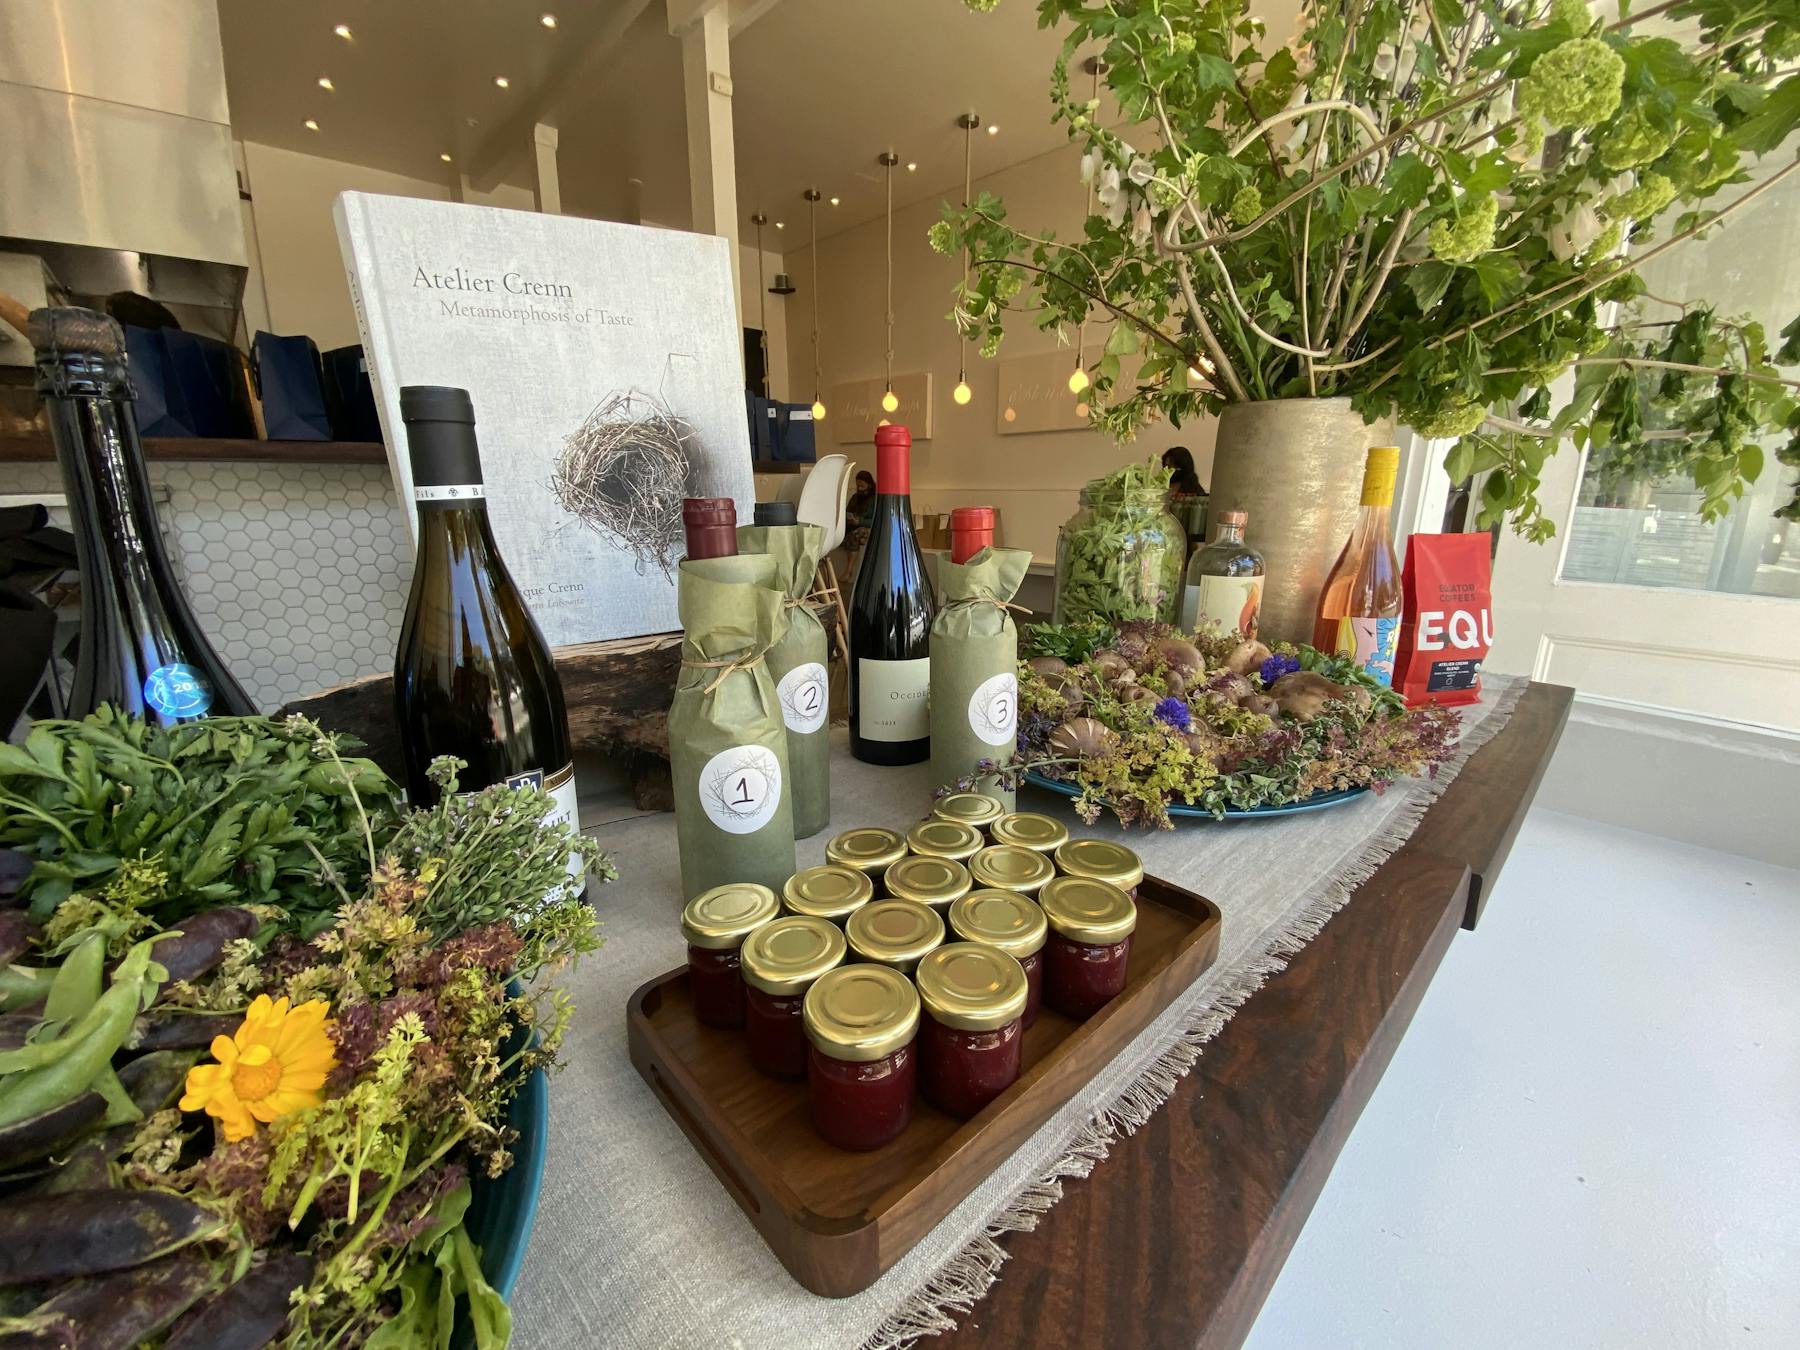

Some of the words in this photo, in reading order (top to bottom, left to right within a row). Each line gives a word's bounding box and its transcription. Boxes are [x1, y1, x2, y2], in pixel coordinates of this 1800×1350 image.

[412, 266, 495, 293] Atelier
[503, 272, 573, 298] Crenn
[440, 300, 570, 326] Metamorphosis
[575, 308, 592, 323] of
[596, 309, 634, 327] Taste
[548, 582, 584, 593] Crenn
[803, 686, 818, 711] 2
[996, 699, 1008, 724] 3
[731, 777, 754, 806] 1
